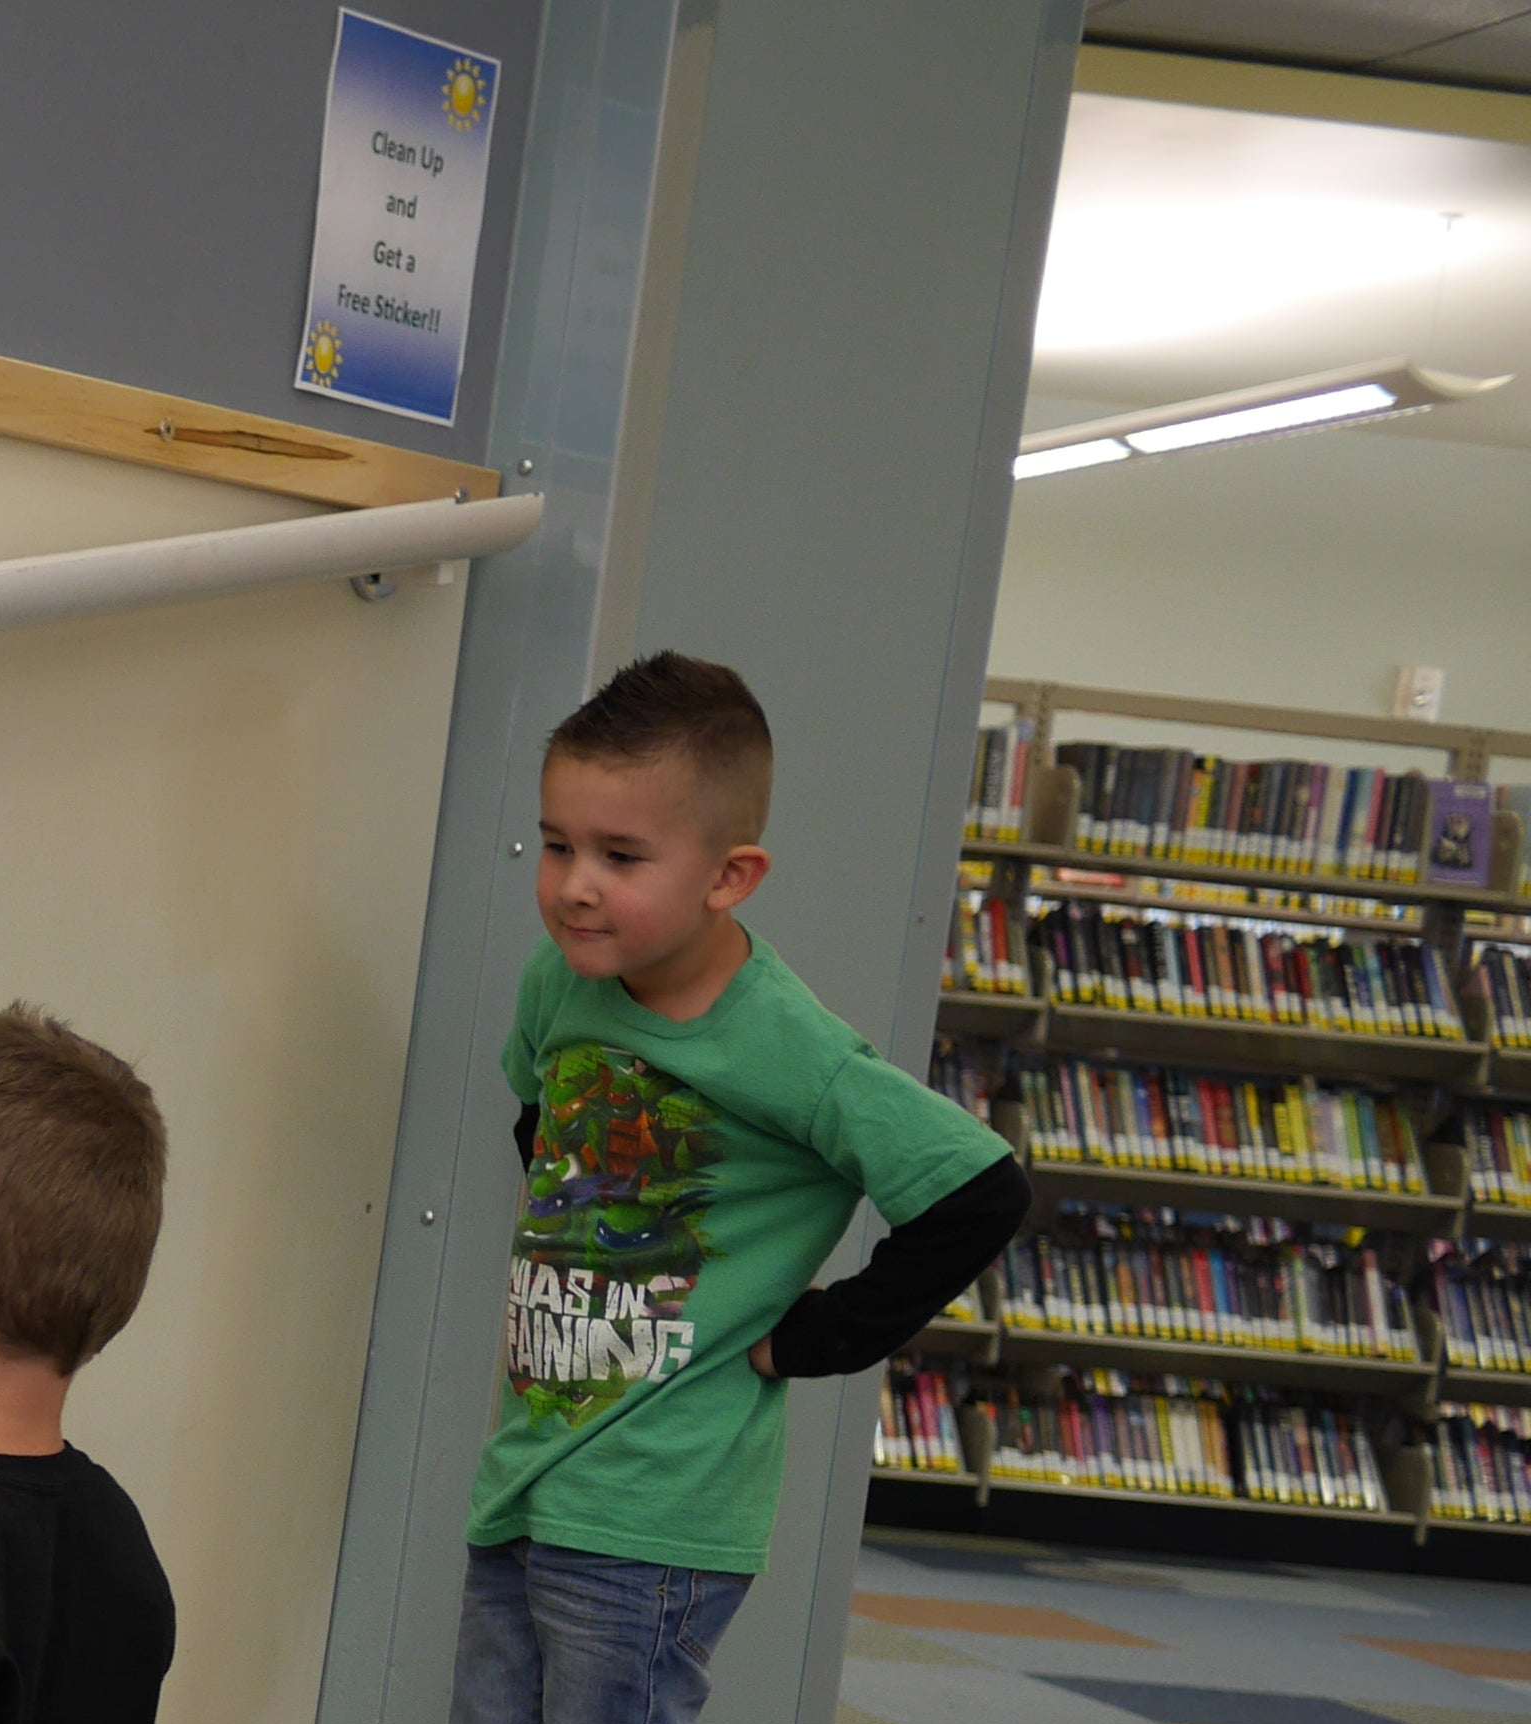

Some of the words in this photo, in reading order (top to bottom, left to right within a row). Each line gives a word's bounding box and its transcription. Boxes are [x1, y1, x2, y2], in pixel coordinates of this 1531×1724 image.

[371, 130, 416, 165] Clean
[421, 145, 444, 178] Up
[386, 195, 418, 219] and
[373, 240, 402, 270] Get
[405, 254, 416, 273] a
[337, 283, 371, 314] Free
[374, 294, 441, 333] Sticker!!
[604, 1280, 646, 1320] IN
